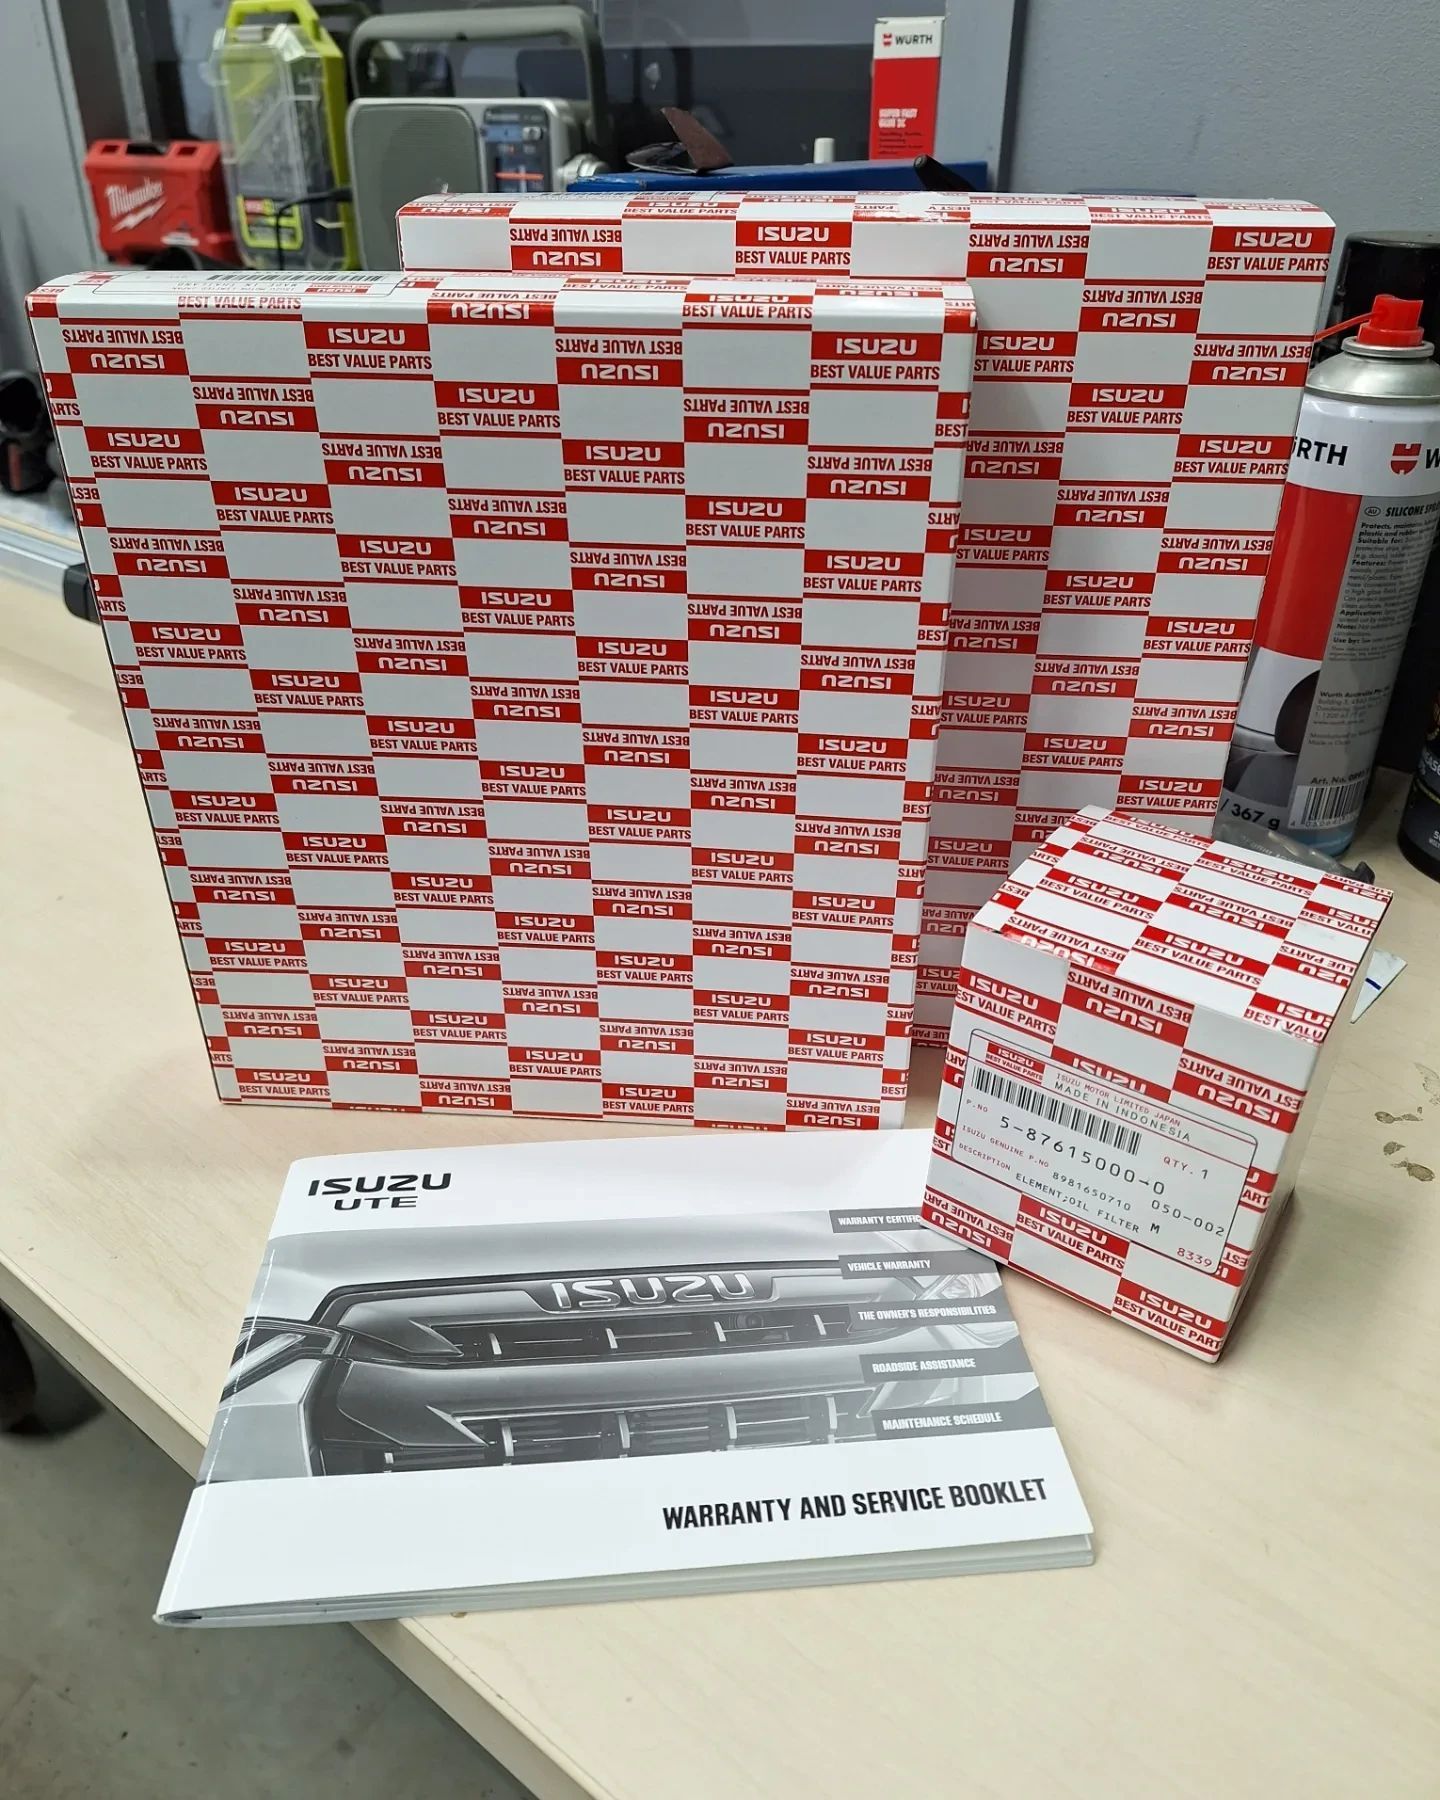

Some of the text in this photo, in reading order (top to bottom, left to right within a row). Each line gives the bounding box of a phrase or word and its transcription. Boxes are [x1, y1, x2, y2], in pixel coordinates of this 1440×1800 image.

[510, 229, 622, 242] BEST VALUE PARTS
[758, 227, 829, 241] ISUZU
[1235, 232, 1312, 247] ISUZU
[533, 251, 600, 266] ISUZU
[736, 251, 850, 264] BEST VALUE PARTS
[1208, 257, 1329, 271] BEST VALUE PARTS
[328, 328, 405, 344] ISUZU
[837, 338, 917, 355] ISUZU
[308, 354, 432, 369] BEST VALUE PARTS
[811, 365, 940, 380] BEST VALUE PARTS
[1092, 389, 1164, 402] ISUZU
[1067, 411, 1182, 424] BEST VALUE PARTS
[108, 433, 180, 447] ISUZU
[91, 456, 207, 470] BEST VALUE PARTS
[1057, 489, 1169, 502] BEST VALUE PARTS
[1076, 510, 1144, 523] ISUZU
[1386, 504, 1424, 516] SILICONE
[688, 602, 802, 618] BEST VALUE PARTS
[710, 624, 779, 639] ISUZU
[272, 675, 339, 687] ISUZU
[254, 693, 364, 706] BEST VALUE PARTS
[583, 732, 689, 746] BEST VALUE PARTS
[605, 750, 669, 763] ISUZU
[1139, 780, 1202, 792] ISUZU
[1117, 796, 1222, 813] BEST VALUE PARTS
[1231, 803, 1264, 821] 367
[1268, 818, 1280, 831] g
[410, 876, 474, 888] ISUZU
[1069, 876, 1140, 902] ISUZU
[395, 893, 493, 904] BEST VALUE PARTS
[1040, 879, 1154, 920] BEST VALUE PARTS
[1166, 935, 1244, 965] ISUZU
[1135, 938, 1262, 984] BEST VALUE PARTS
[791, 969, 890, 984] BEST VALUE PARTS
[809, 985, 869, 998] ISUZU
[1068, 972, 1192, 1024] BEST VALUE PARTS
[1086, 997, 1162, 1034] ISUZU
[998, 1047, 1034, 1068] ISUZU
[985, 1053, 1043, 1081] BEST VALUE PARTS
[1180, 1057, 1272, 1103] VALUE PARTS
[1056, 1073, 1181, 1126] ISUZU MOTOR LIMITED JAPAN
[1197, 1084, 1280, 1124] ISUZU
[1054, 1081, 1191, 1142] MADE IN INDONESIA
[962, 1125, 986, 1140] ISUZU
[989, 1136, 1025, 1157] GENUINE
[958, 1142, 1011, 1171] DESCRIPTION
[1201, 1169, 1209, 1179] 1
[307, 1172, 452, 1197] ISUZU
[1052, 1172, 1132, 1211] 8981650710
[333, 1195, 418, 1212] UTE
[838, 1216, 884, 1226] WARRANTY
[1040, 1207, 1108, 1244] ISUZU
[1097, 1208, 1140, 1233] FILTER
[1151, 1200, 1225, 1237] 050-002
[1150, 1222, 1160, 1234] M
[1016, 1214, 1125, 1269] BEST VALUE PARTS
[1176, 1247, 1213, 1267] 8339
[848, 1260, 931, 1272] VEHICLE WARRANTY
[550, 1272, 755, 1310] ISUZU
[858, 1305, 997, 1321] THE OWNER'S RESPONSIBILITIES
[1114, 1297, 1184, 1335] BEST VALUE
[1140, 1290, 1212, 1329] ISUZU
[872, 1358, 976, 1373] ROADSIDE ASSISTANCE
[882, 1412, 1003, 1431] MAINTENANCE SCHEDULE
[662, 1476, 1048, 1530] WARRANTY AND SERVICE BOOKLET
